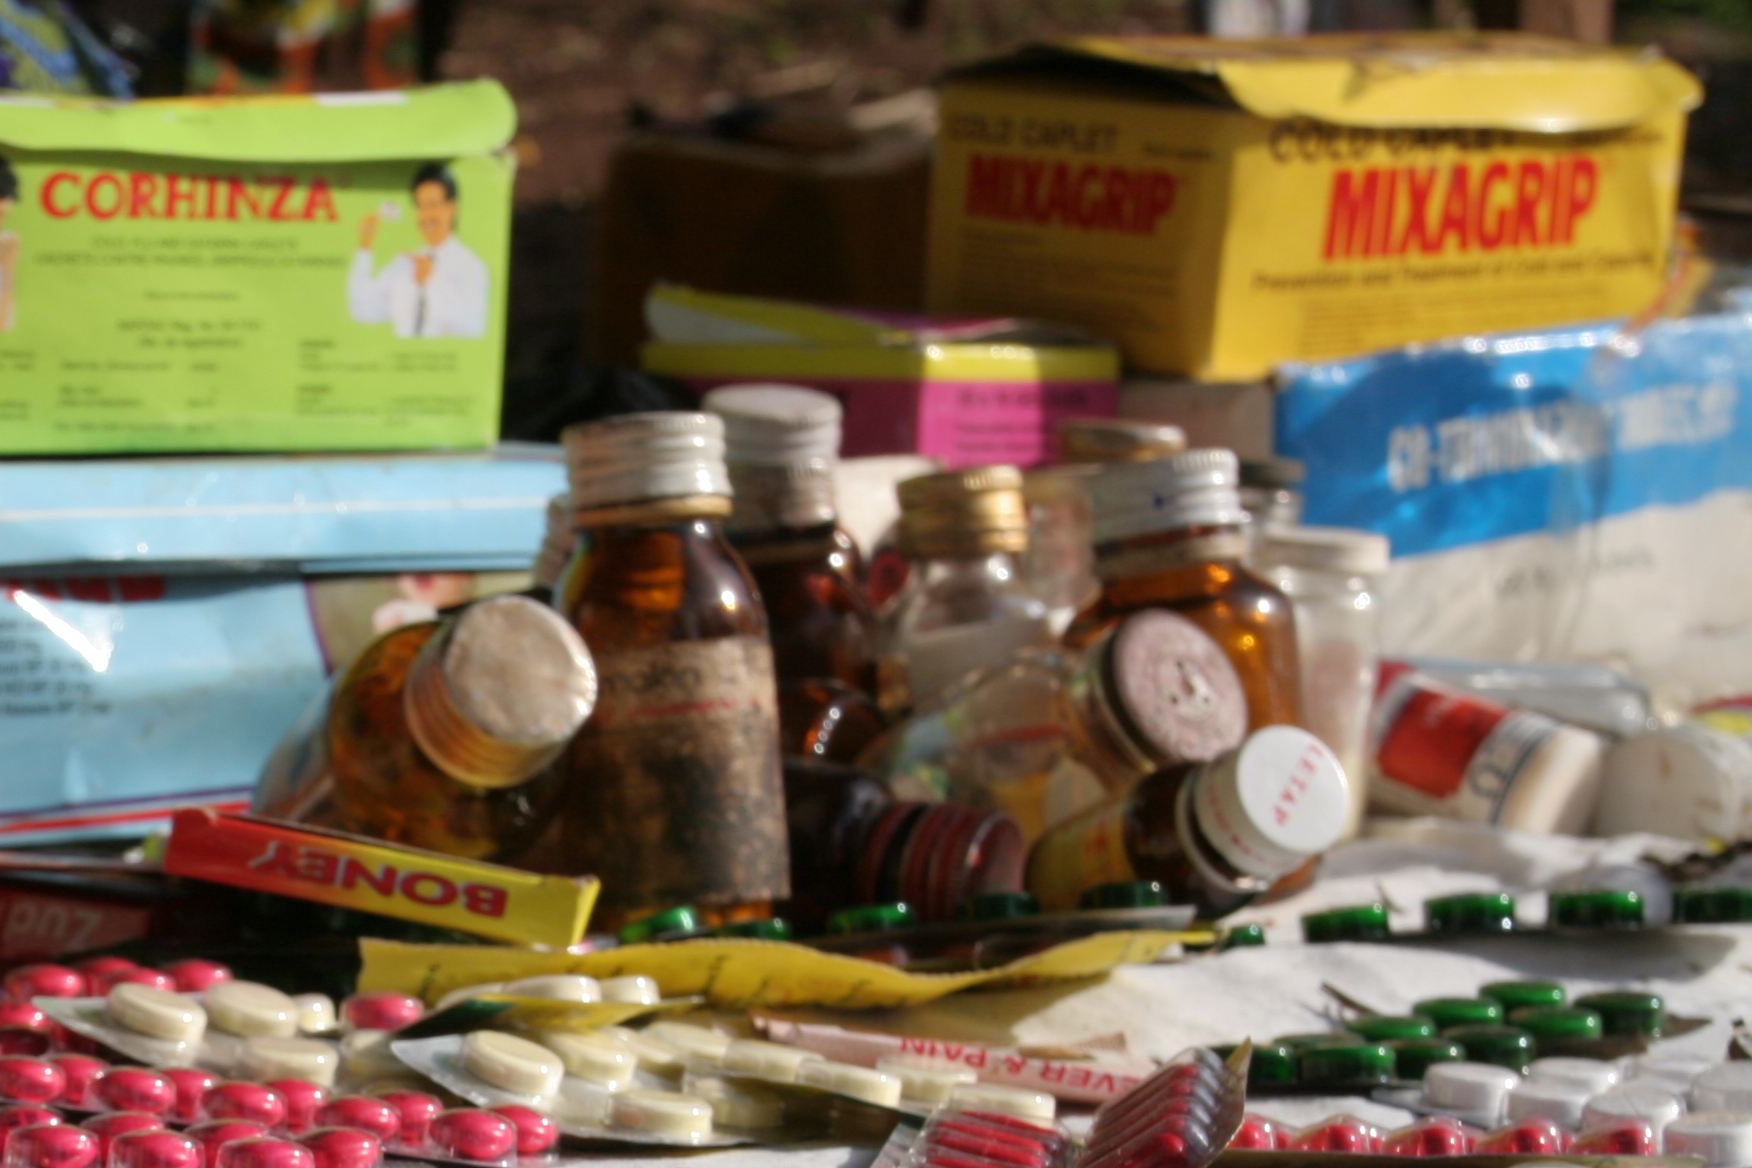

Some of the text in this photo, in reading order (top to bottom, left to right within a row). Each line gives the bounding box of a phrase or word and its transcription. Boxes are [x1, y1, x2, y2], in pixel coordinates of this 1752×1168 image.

[38, 168, 340, 224] CORHINZA
[964, 150, 1177, 236] MIXAGRIP
[1322, 152, 1603, 264] MIXAGRIP
[1273, 742, 1326, 828] LETAP
[250, 839, 508, 919] BONEY
[898, 1036, 987, 1069] PAIN
